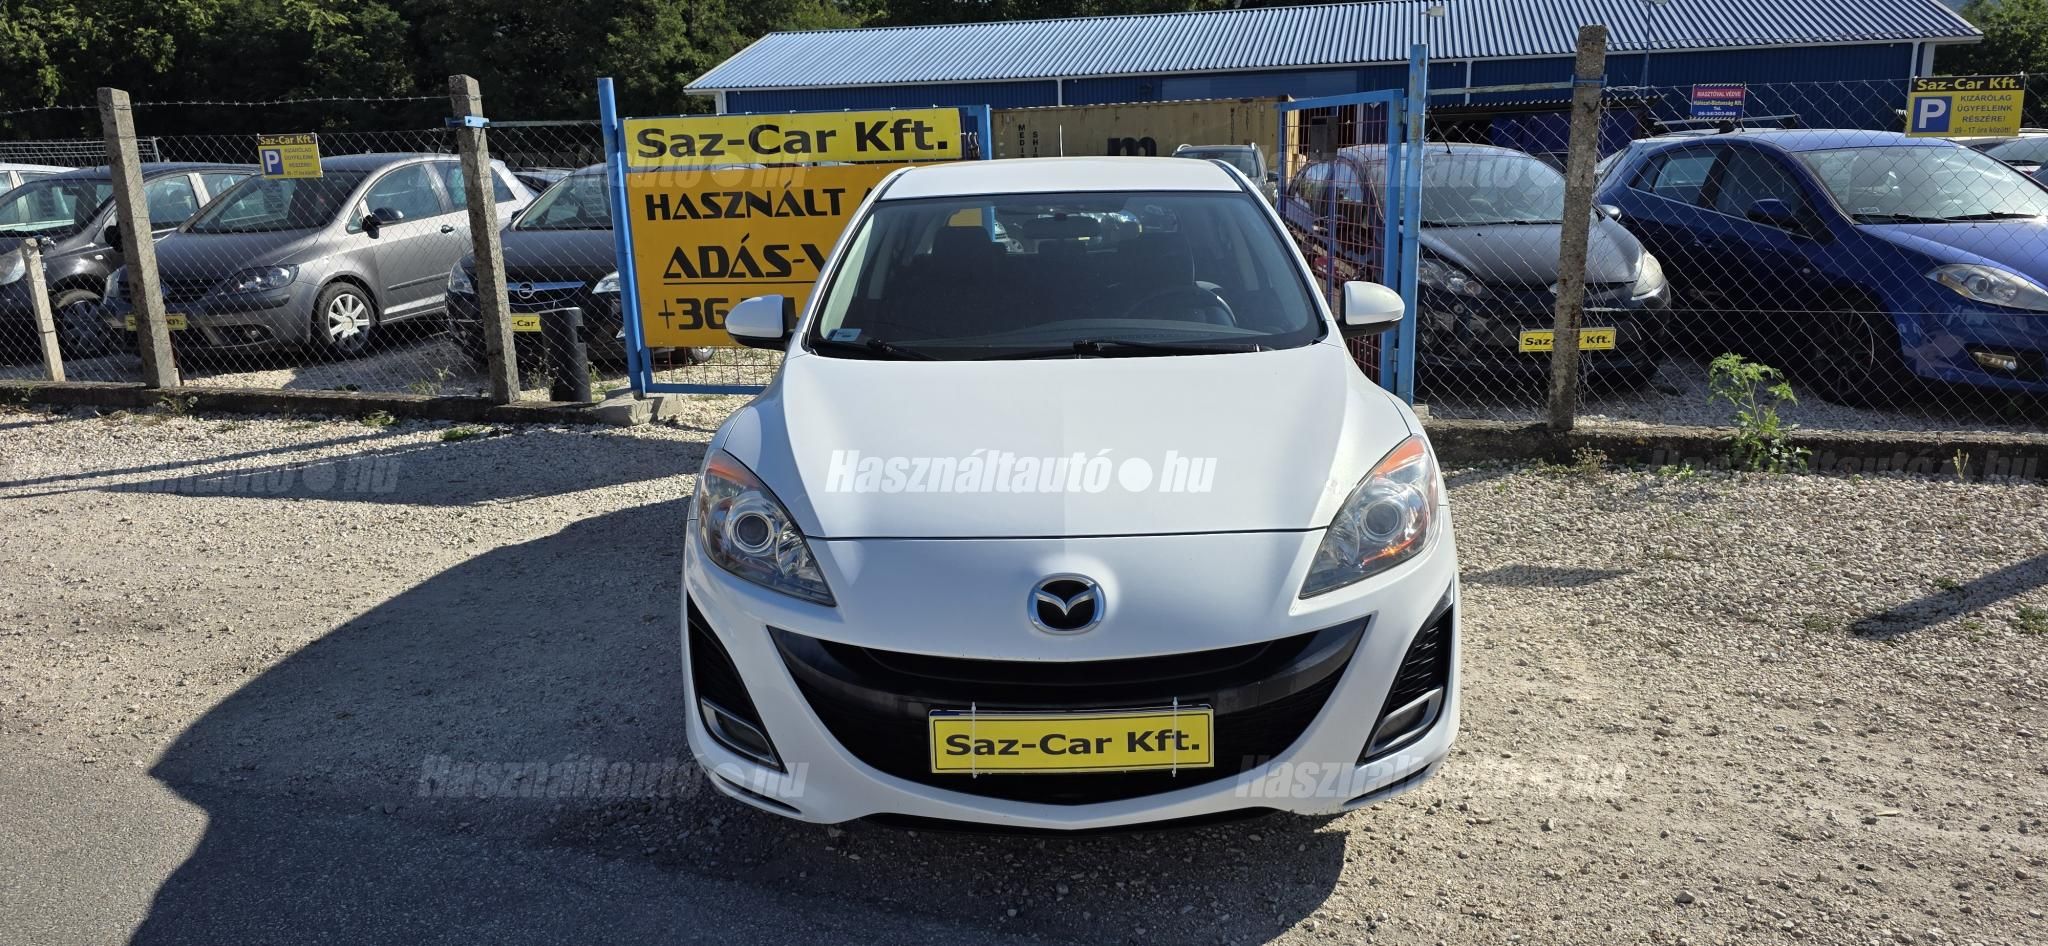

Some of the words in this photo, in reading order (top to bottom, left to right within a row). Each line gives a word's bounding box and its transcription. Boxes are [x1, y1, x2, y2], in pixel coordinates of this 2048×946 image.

[1917, 78, 1984, 91] Saz-Car
[1989, 77, 2020, 89] Kft.
[1960, 94, 2012, 102] KIZÁRÓLAG
[260, 136, 294, 145] Saz-Car
[296, 135, 314, 144] Kft.
[637, 123, 837, 158] Saz-Car
[855, 118, 948, 152] Kft.
[645, 180, 846, 221] HASZNÁLT
[664, 232, 828, 279] ADÁS-V
[512, 319, 536, 327] -Car
[1586, 335, 1611, 344] Kft.
[945, 733, 1112, 756] Saz-Car
[1127, 728, 1200, 753] Kft.
